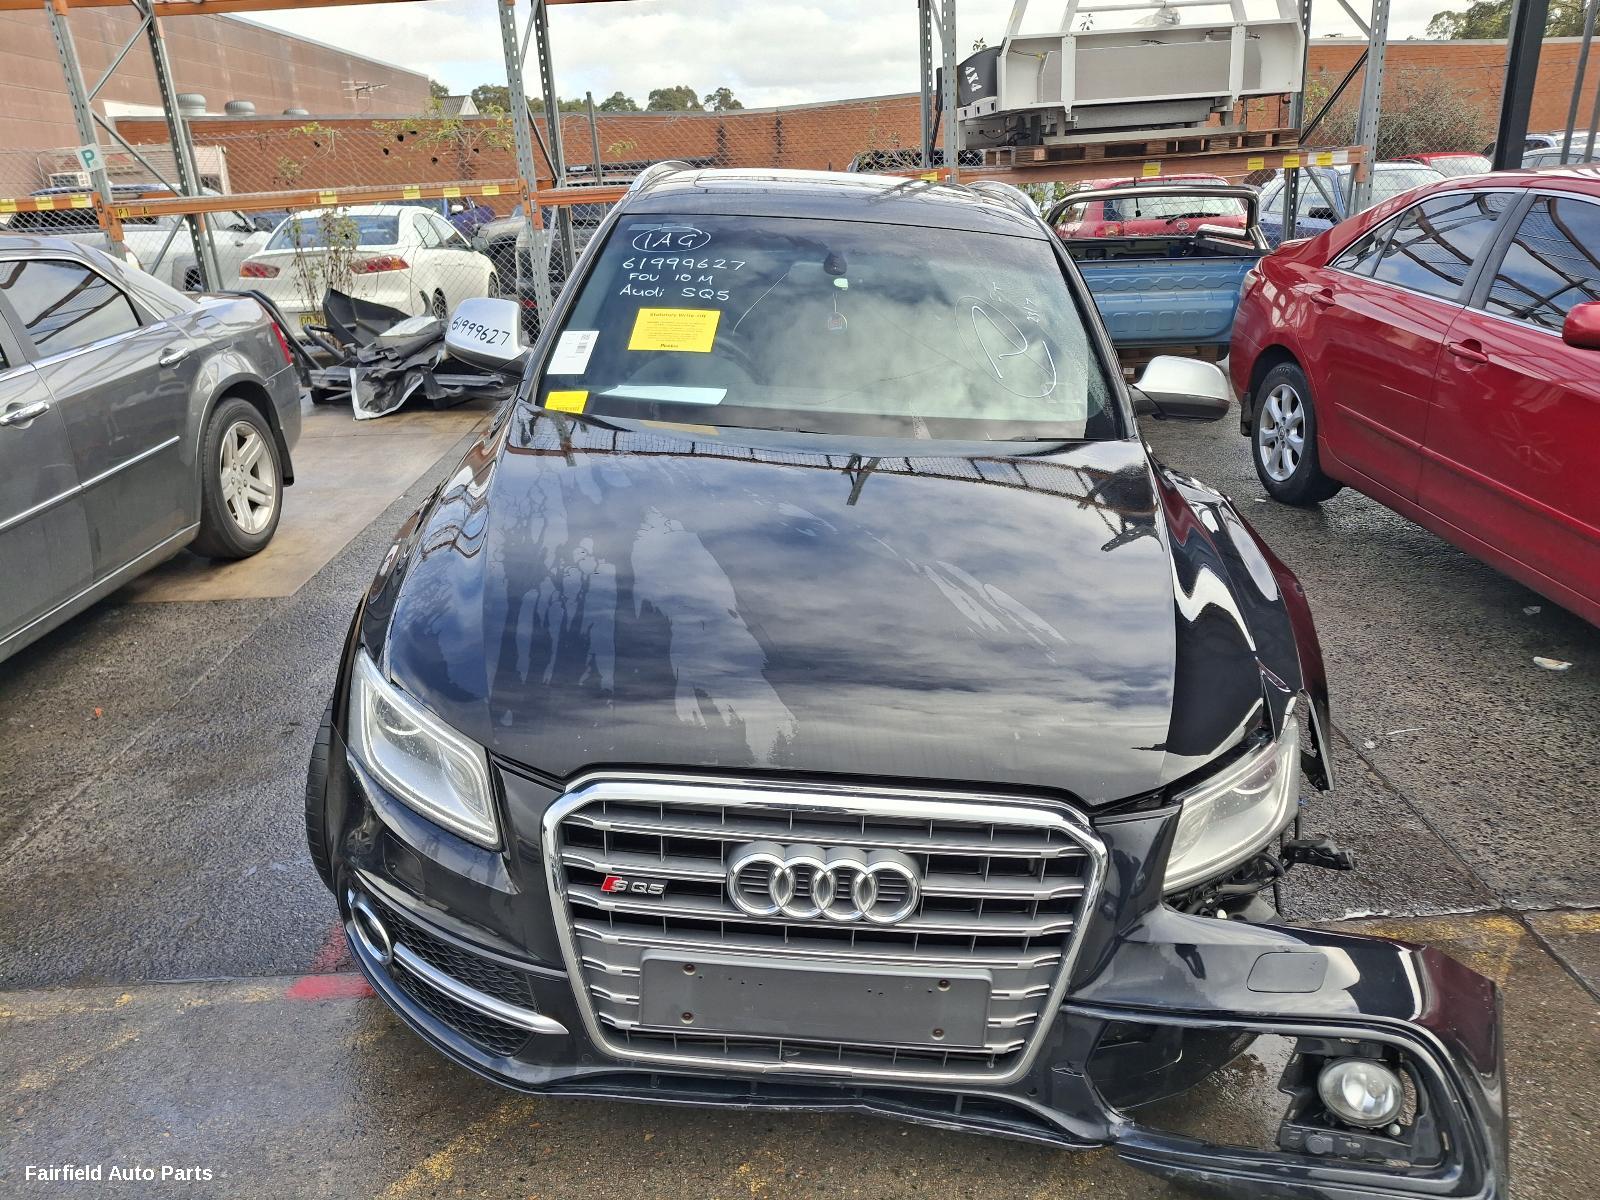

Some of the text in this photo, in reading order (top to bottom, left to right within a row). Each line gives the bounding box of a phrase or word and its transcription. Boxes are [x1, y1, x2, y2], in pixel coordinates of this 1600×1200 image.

[81, 149, 95, 168] P
[622, 257, 746, 270] 61999627
[675, 273, 691, 282] 10
[698, 275, 713, 285] M
[619, 283, 729, 301] Audi SQ5
[451, 316, 511, 346] 61999627
[607, 877, 665, 895] SQ5
